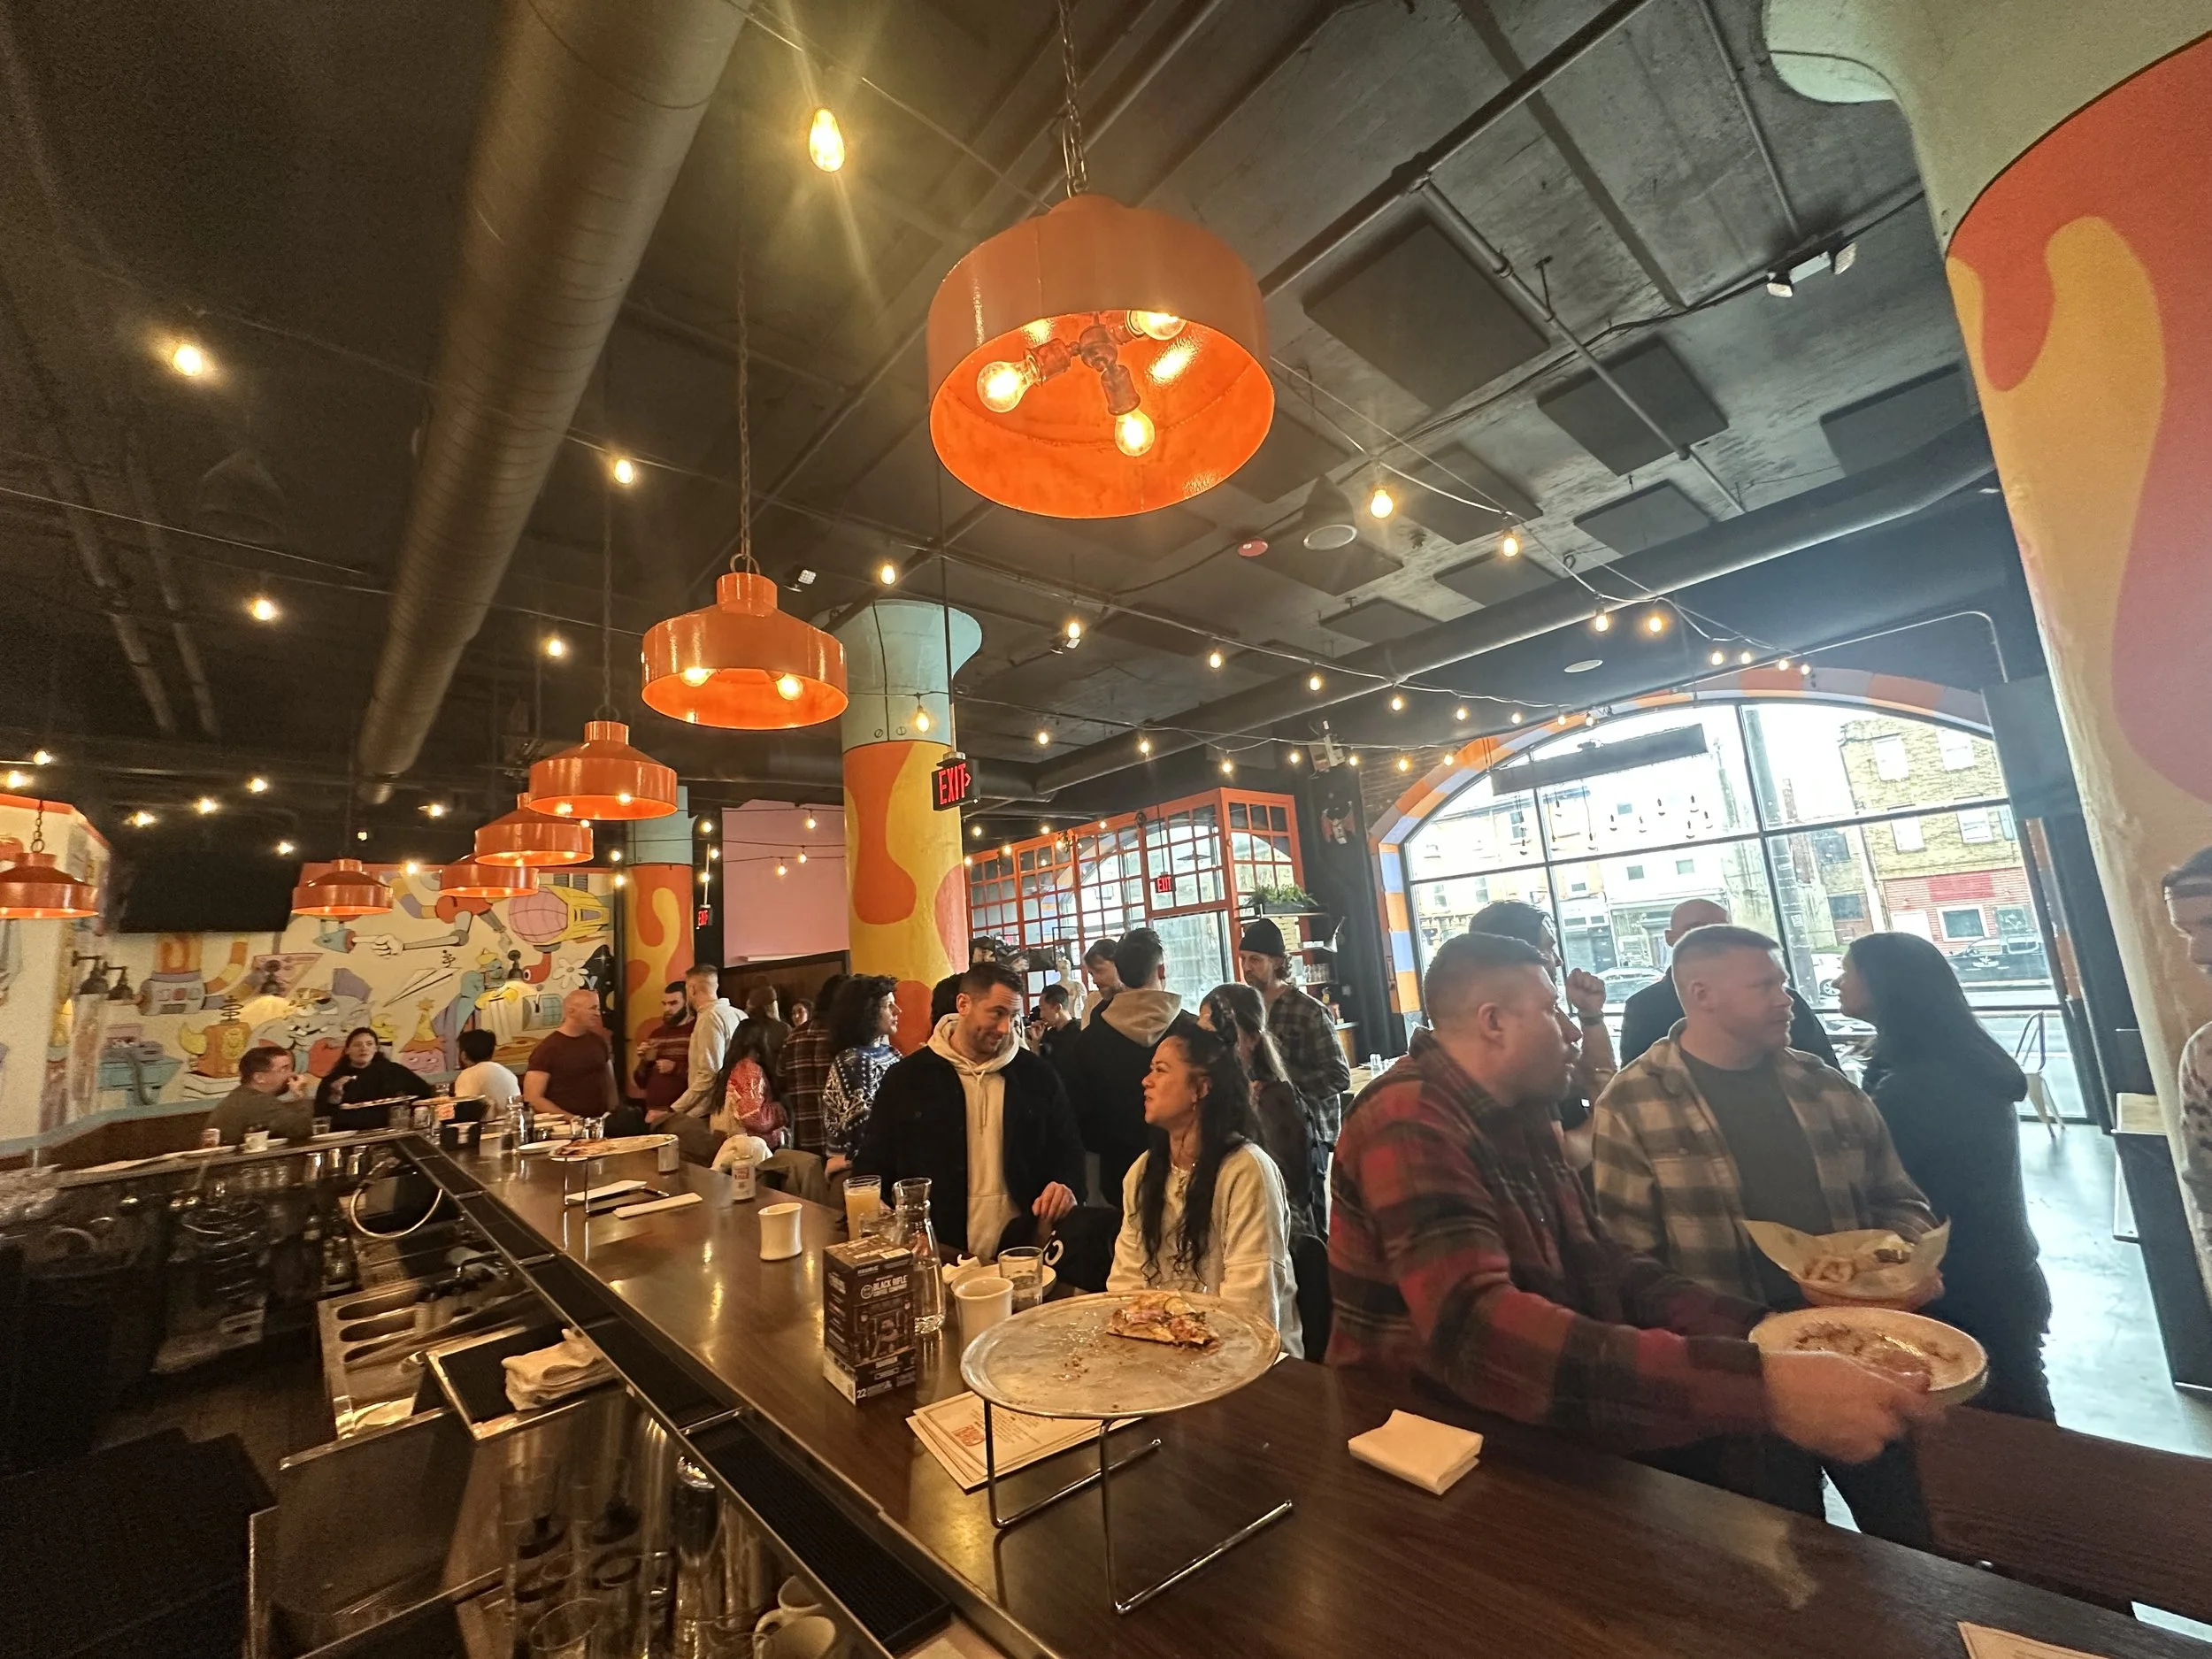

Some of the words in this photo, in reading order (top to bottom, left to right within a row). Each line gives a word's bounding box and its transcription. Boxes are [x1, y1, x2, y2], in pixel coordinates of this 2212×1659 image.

[939, 763, 965, 804] EXIT
[1157, 876, 1171, 892] EXIT
[872, 1279, 891, 1291] BLACK
[892, 1274, 908, 1286] RIFLE
[856, 1387, 866, 1399] 22
